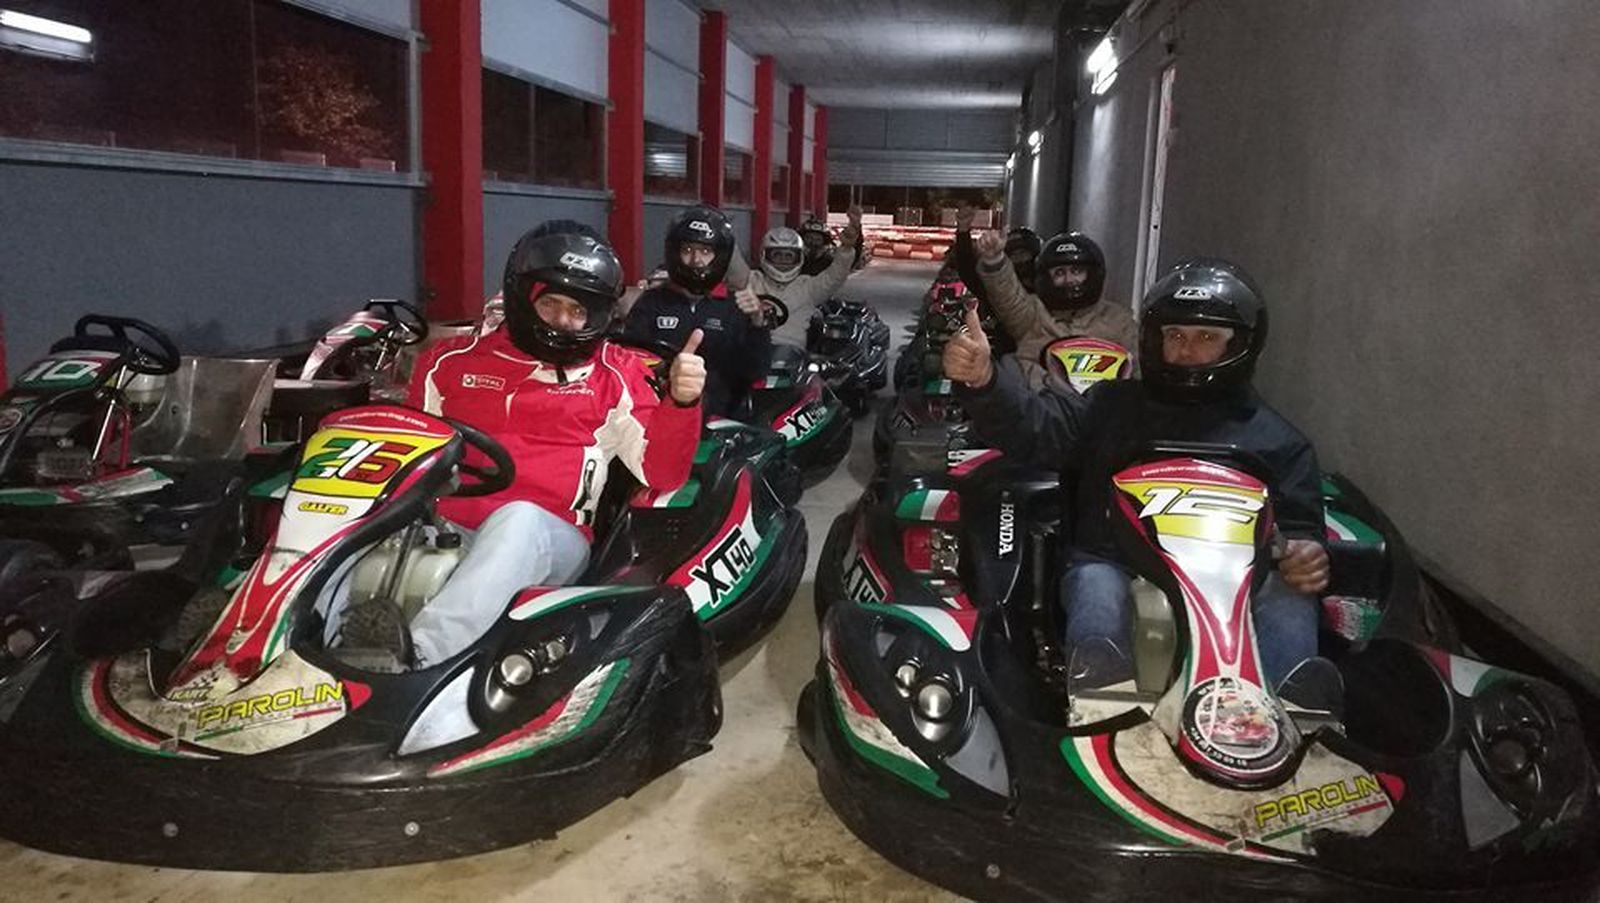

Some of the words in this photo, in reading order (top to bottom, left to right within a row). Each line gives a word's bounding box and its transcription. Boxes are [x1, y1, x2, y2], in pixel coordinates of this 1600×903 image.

[24, 360, 102, 382] 10
[1068, 353, 1118, 374] 17
[298, 438, 418, 485] 26
[998, 503, 1015, 557] HONDA
[1139, 487, 1265, 525] 12
[691, 526, 755, 606] XT40
[196, 681, 344, 730] PAROLIN
[1254, 773, 1381, 829] PAROLIN
